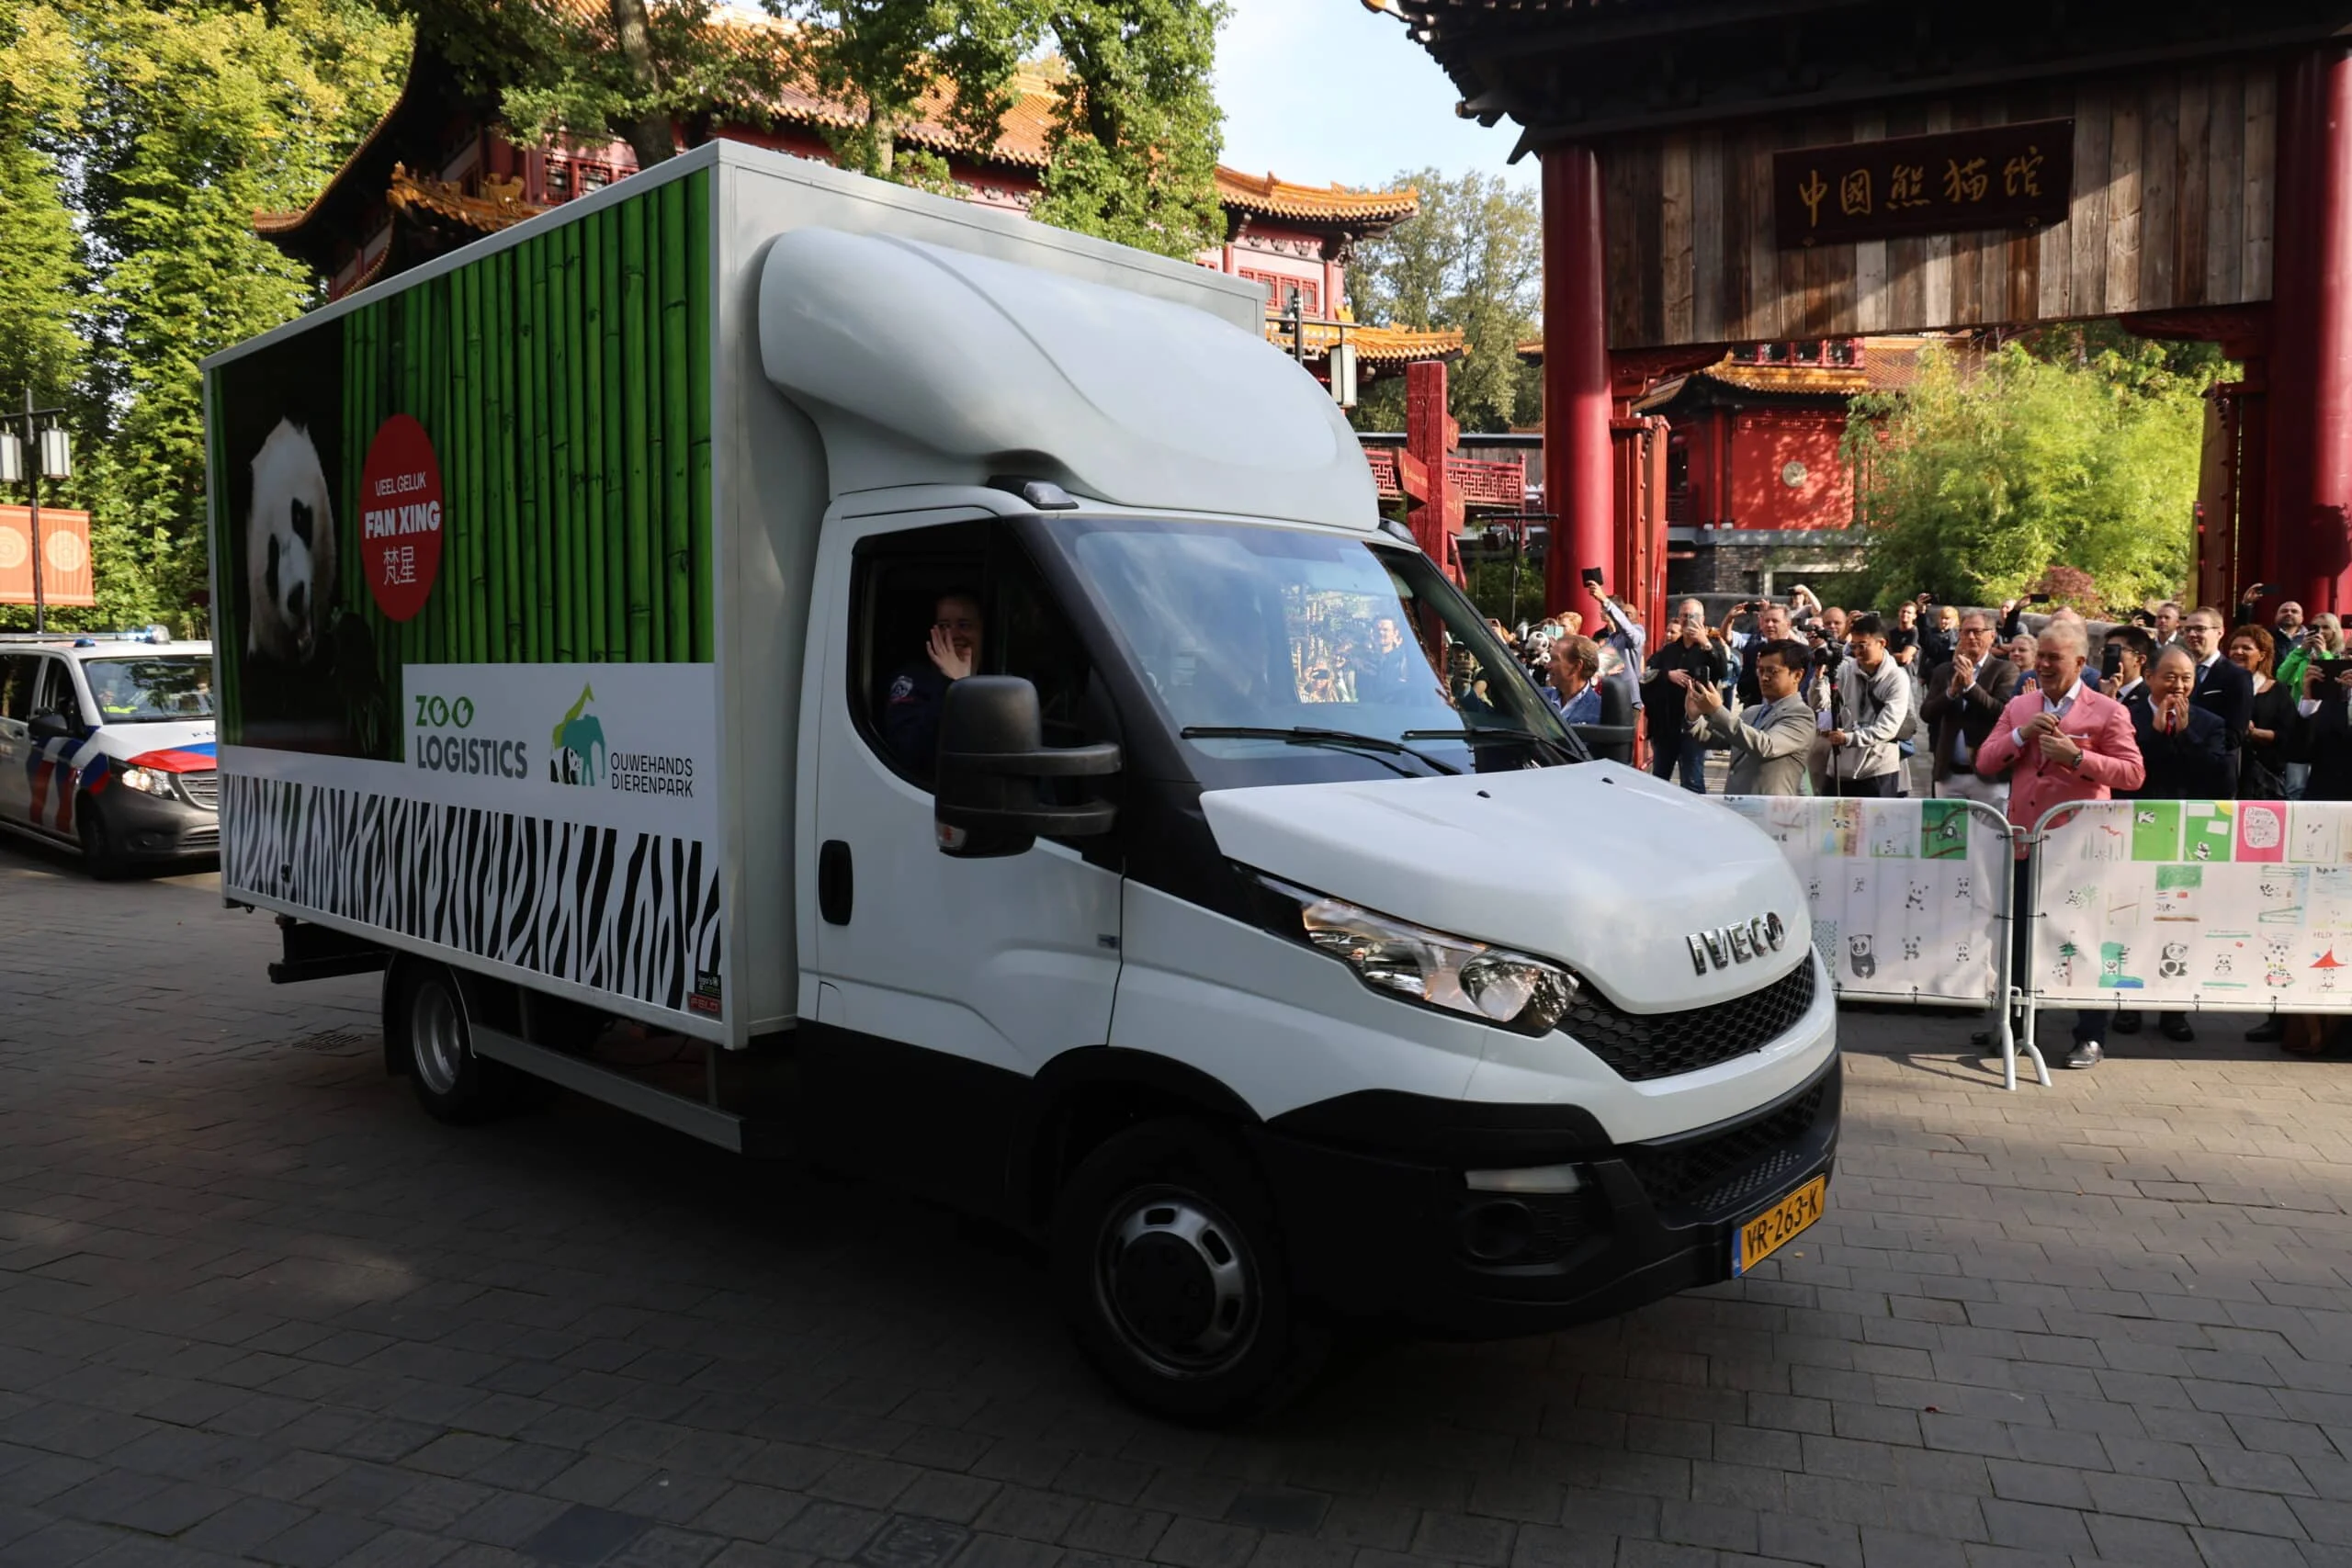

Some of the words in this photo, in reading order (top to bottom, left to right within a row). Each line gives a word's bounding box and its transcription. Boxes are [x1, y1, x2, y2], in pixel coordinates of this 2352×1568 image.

[375, 478, 397, 497] VEEL
[397, 471, 426, 493] GELUK
[365, 507, 395, 539] FAN
[398, 500, 441, 535] XING
[383, 546, 417, 586] 梵星
[415, 695, 474, 728] ZOO
[417, 735, 528, 780] LOGISTICS
[610, 751, 694, 777] OUWEHANDS
[611, 773, 694, 798] DIERENPARK
[1685, 911, 1786, 976] IVECO
[1747, 1185, 1818, 1259] VR-263-K
